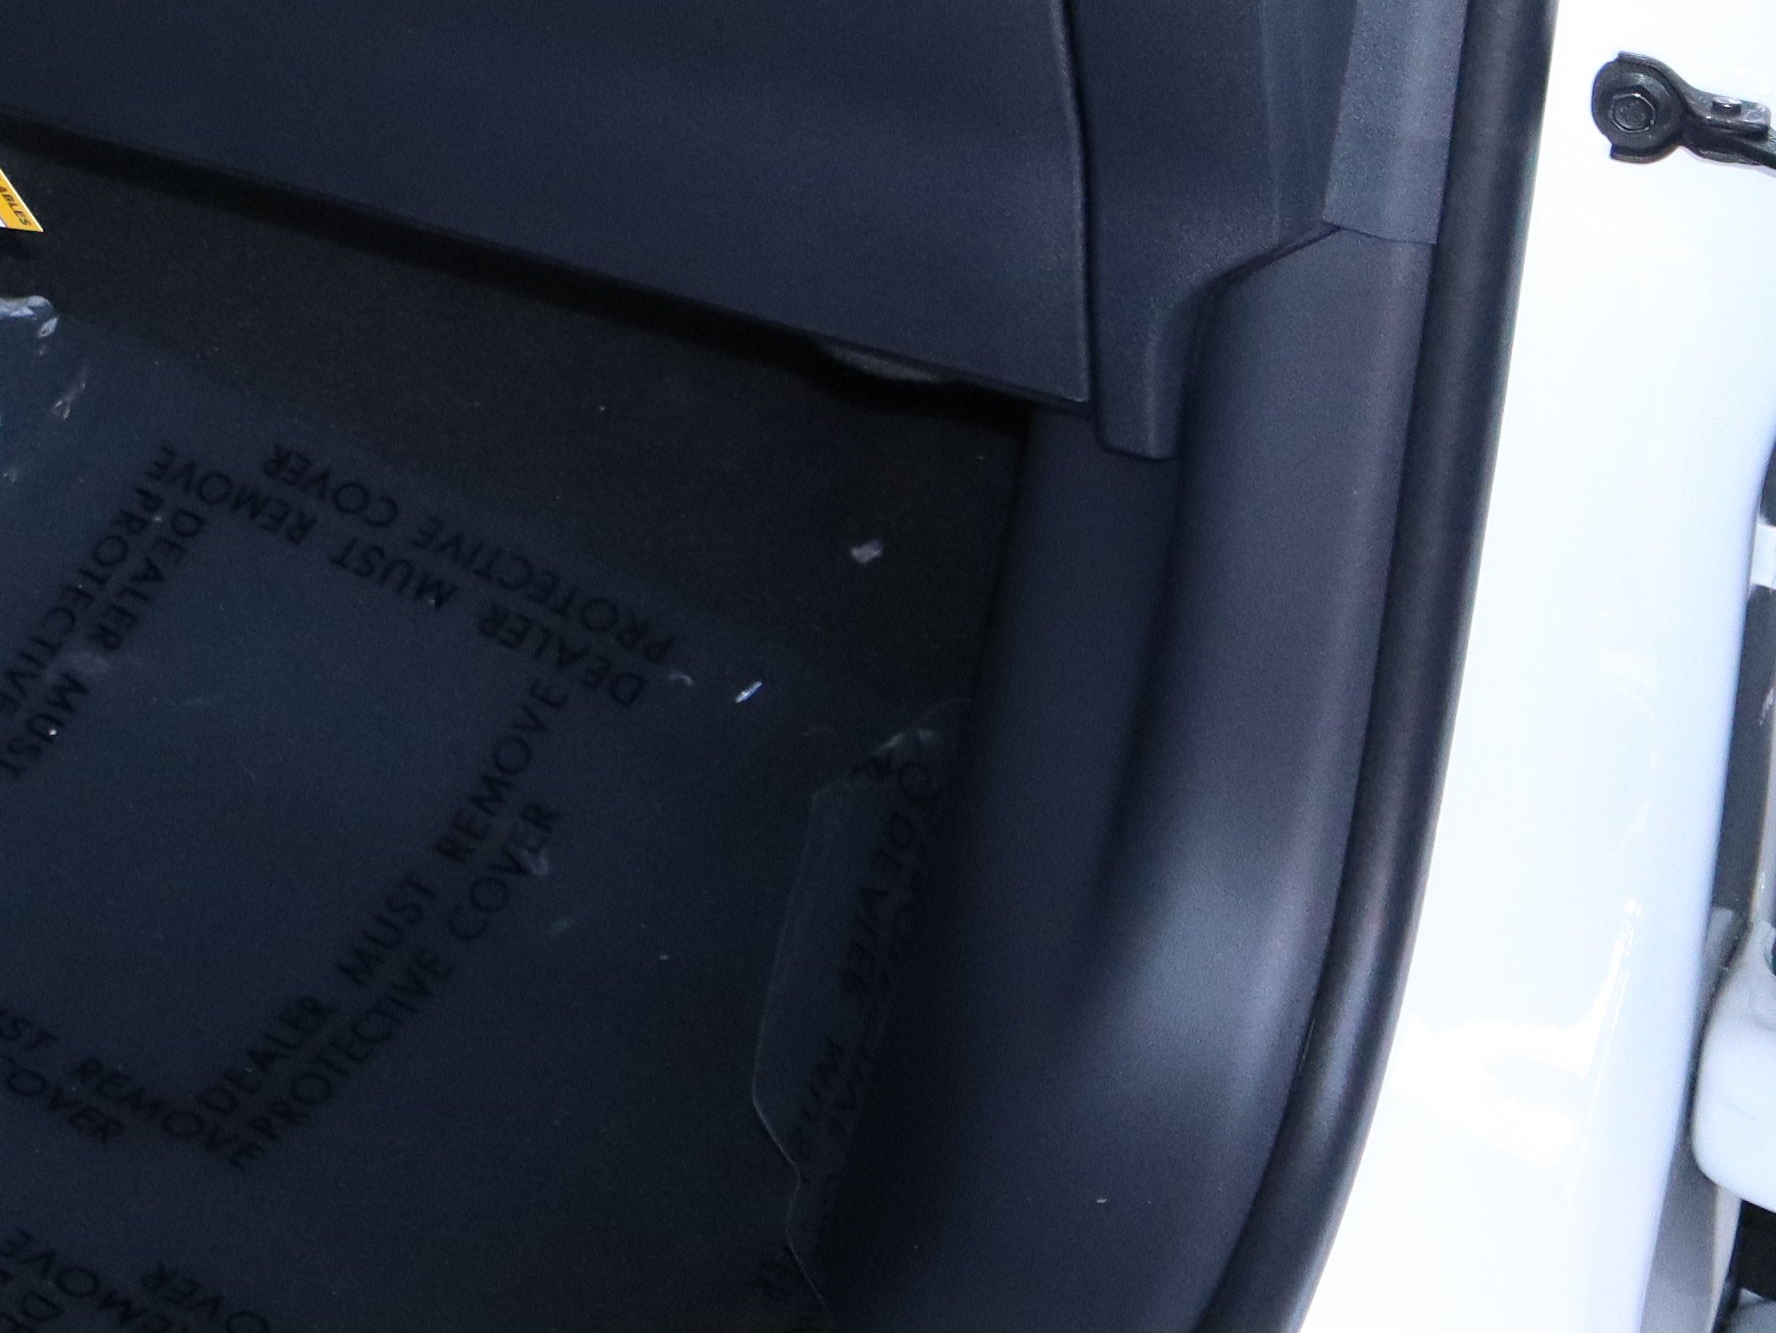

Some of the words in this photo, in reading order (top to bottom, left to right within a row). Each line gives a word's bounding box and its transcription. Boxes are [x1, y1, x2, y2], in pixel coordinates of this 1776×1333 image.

[159, 442, 318, 545] REMOVE
[253, 442, 406, 531] COVER
[93, 511, 206, 652] DEALER
[327, 533, 461, 612] MUST
[403, 512, 686, 663] PROTECTIVE
[463, 601, 658, 708] DEALER
[198, 995, 335, 1118] DEALER
[339, 872, 440, 983] MUST
[436, 678, 567, 858] REMOVE
[259, 953, 457, 1147] PROTECTIVE
[446, 800, 559, 946] COVER
[63, 1051, 268, 1179] REMOVE
[143, 1264, 270, 1333] OVER
